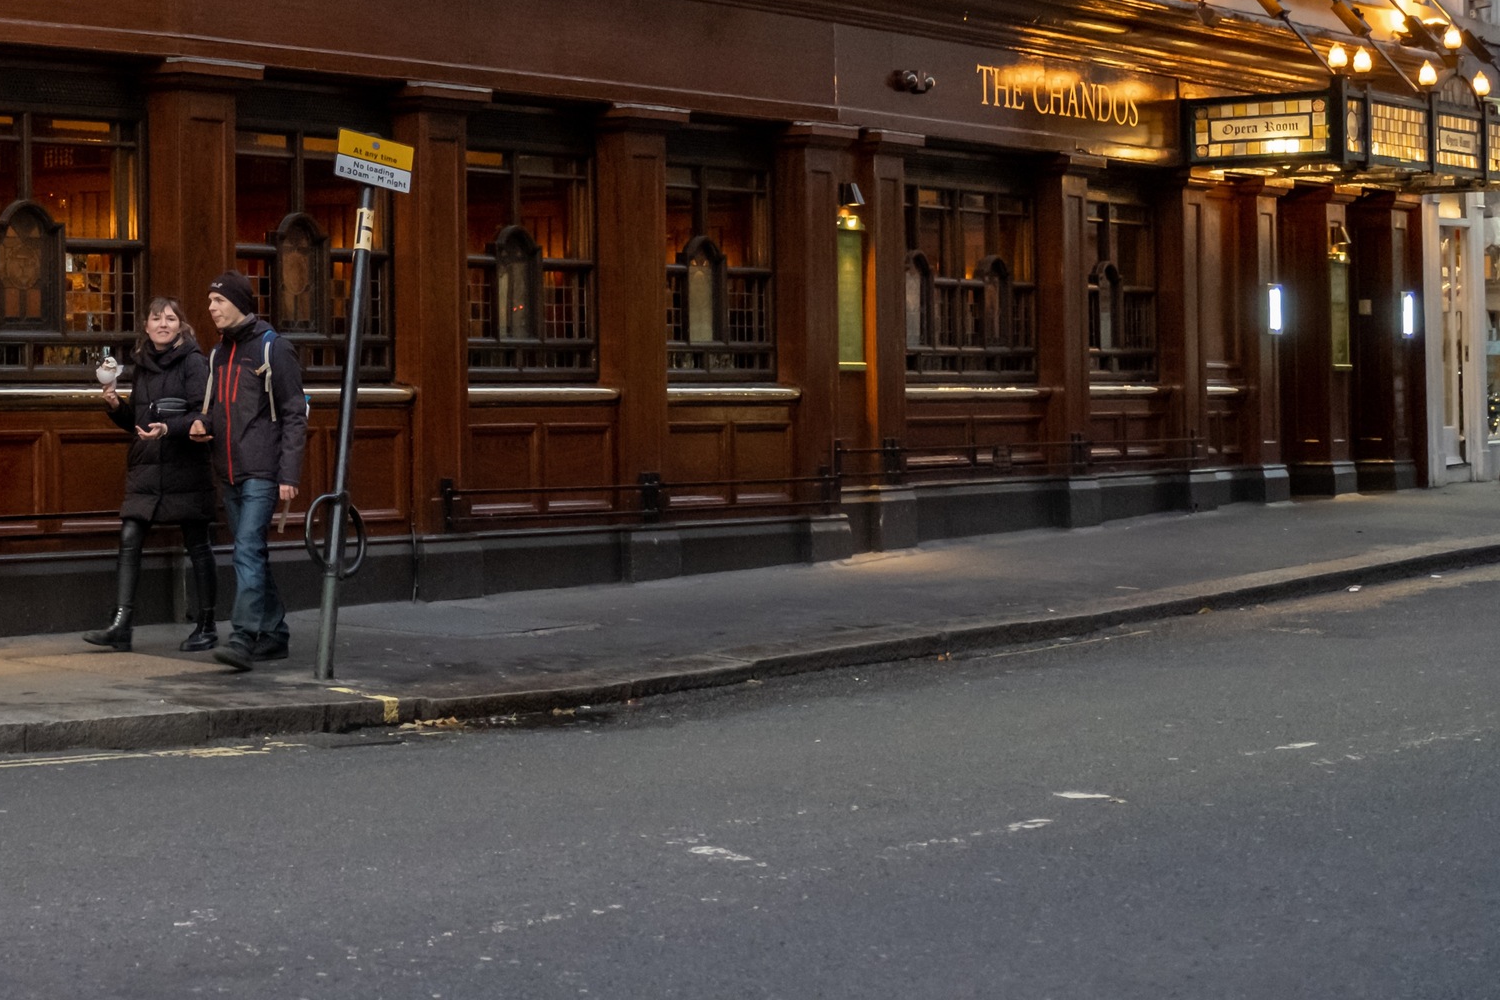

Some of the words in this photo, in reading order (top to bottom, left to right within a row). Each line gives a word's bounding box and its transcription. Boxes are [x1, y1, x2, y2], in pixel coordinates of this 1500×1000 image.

[976, 63, 1025, 111] THE
[1033, 73, 1139, 127] CHANDOS
[1222, 123, 1258, 136] Opera
[1264, 121, 1299, 132] Room
[353, 147, 362, 155] At
[364, 150, 378, 160] any
[380, 154, 398, 164] time
[339, 165, 370, 179] 8.30am
[353, 161, 365, 170] No
[366, 164, 395, 179] loading
